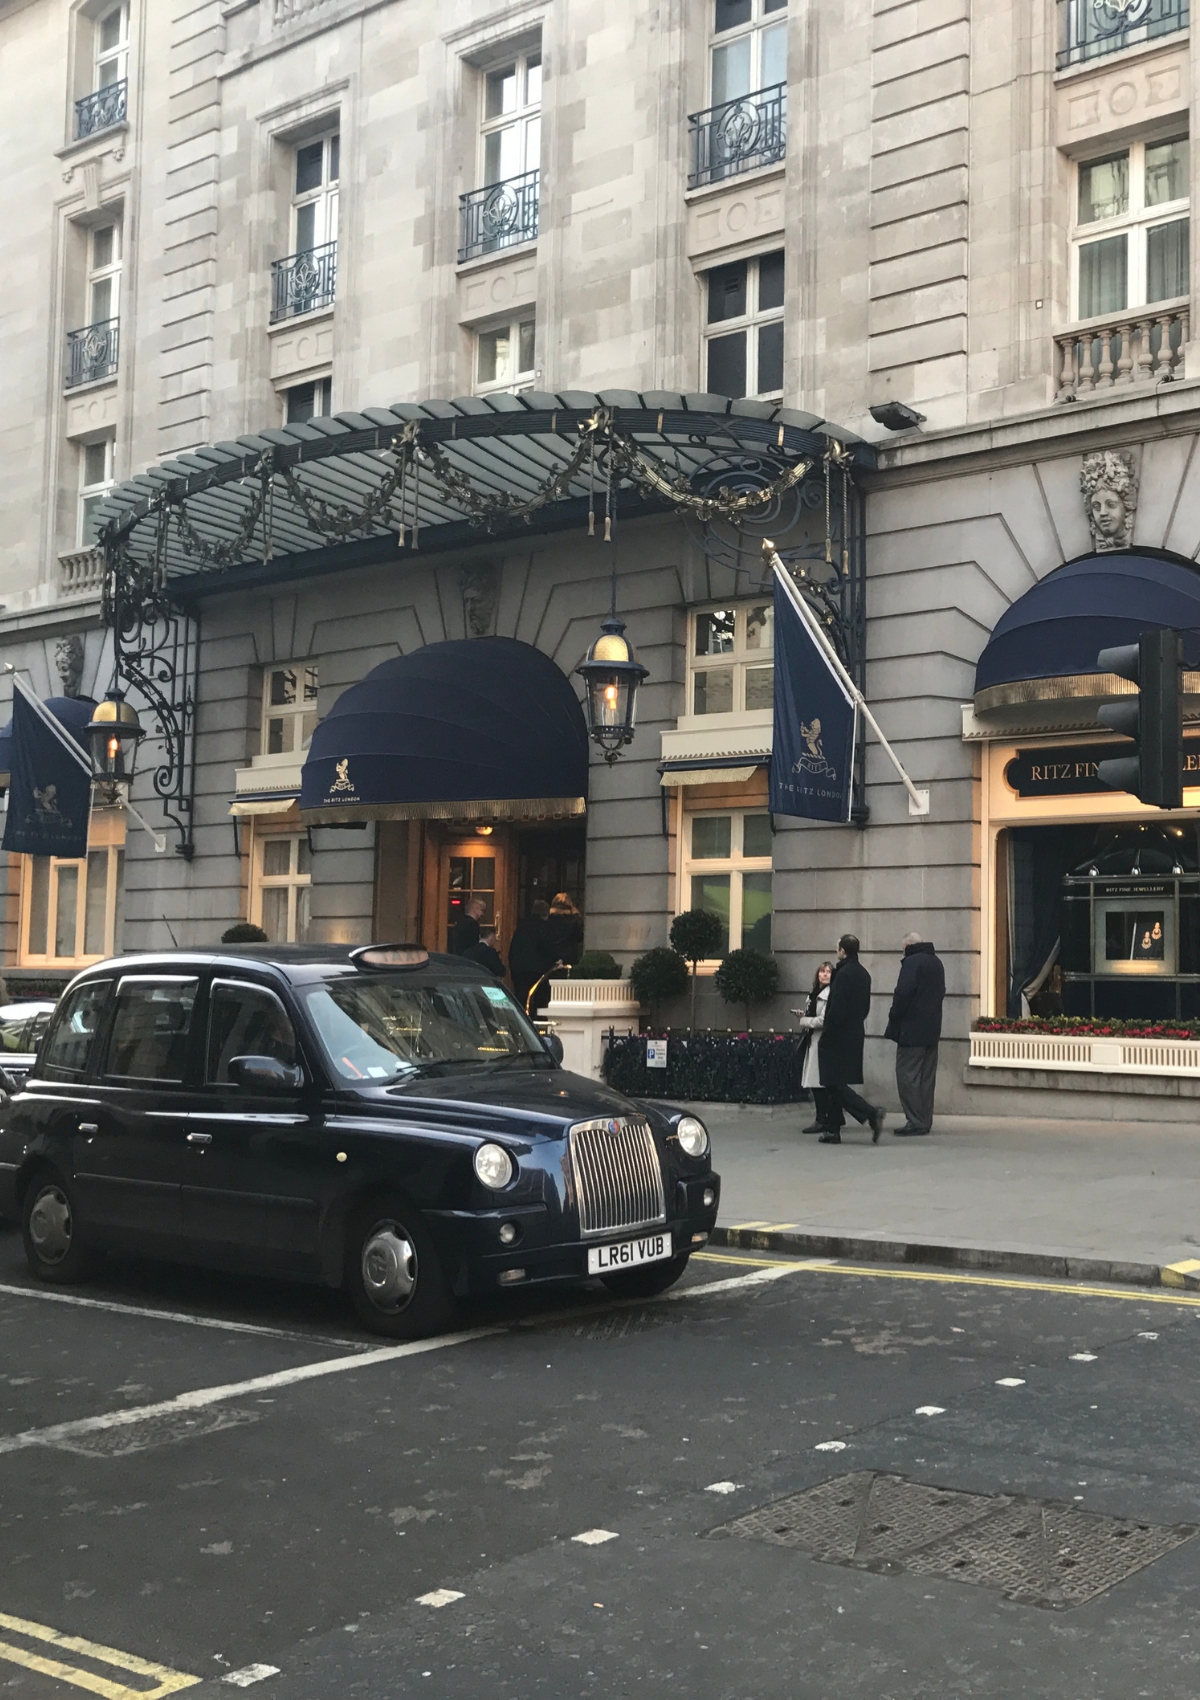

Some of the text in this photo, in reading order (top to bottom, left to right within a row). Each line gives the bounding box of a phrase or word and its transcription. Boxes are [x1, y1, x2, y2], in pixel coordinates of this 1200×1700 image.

[1031, 761, 1100, 781] RITZ FIN
[598, 1236, 664, 1268] LR61 VUB
